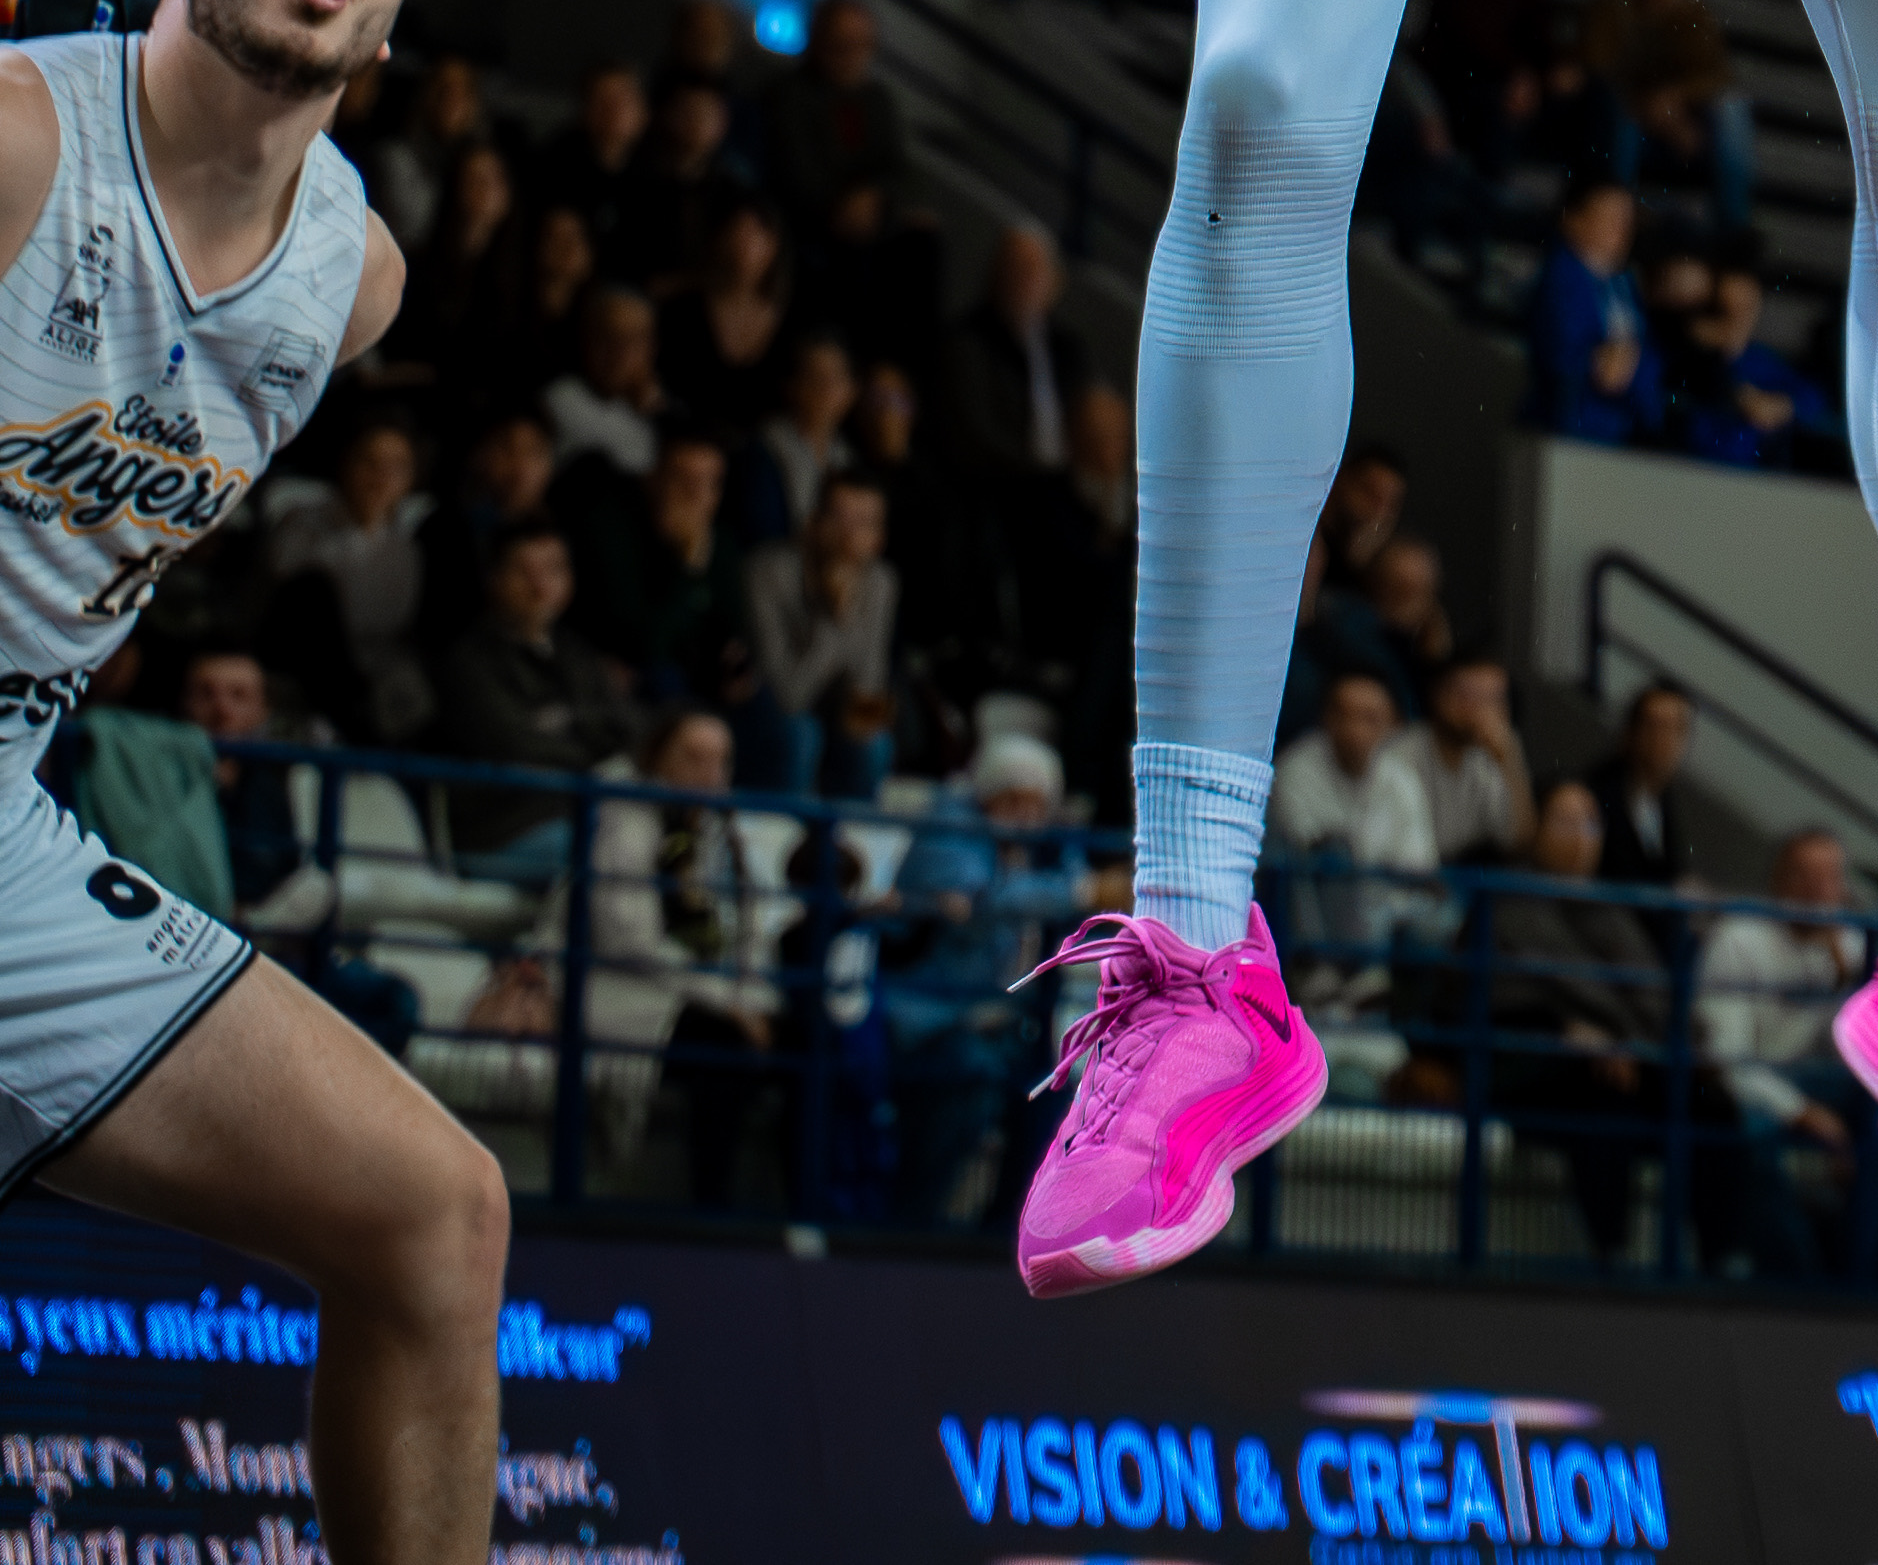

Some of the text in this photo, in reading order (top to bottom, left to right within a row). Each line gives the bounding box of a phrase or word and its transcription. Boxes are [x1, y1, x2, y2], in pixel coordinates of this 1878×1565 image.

[938, 1403, 1669, 1551] VISION & CRÉATION
